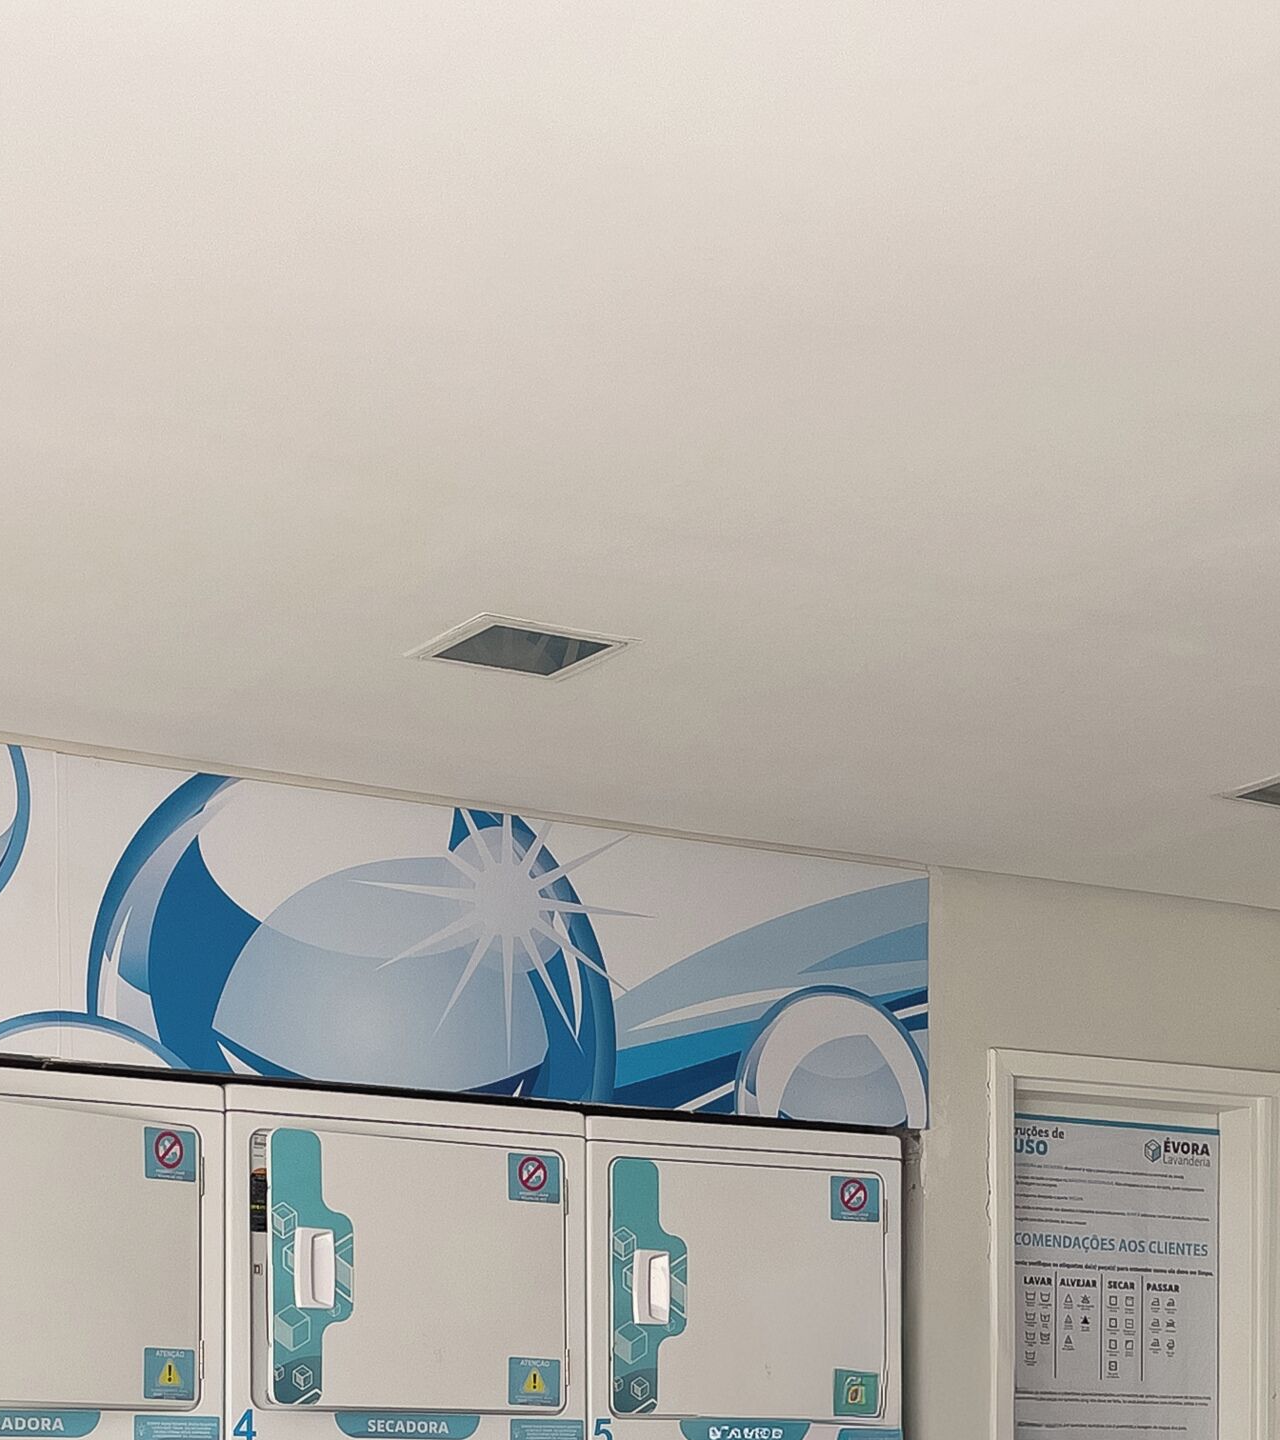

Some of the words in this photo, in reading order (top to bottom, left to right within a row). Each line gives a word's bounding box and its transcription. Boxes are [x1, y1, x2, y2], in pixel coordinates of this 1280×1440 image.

[1052, 1127, 1065, 1139] de
[1163, 1137, 1210, 1156] ÉVORA
[1163, 1154, 1211, 1167] Lavanderia
[1118, 1238, 1145, 1253] AOS
[1149, 1240, 1208, 1257] CLIENTES
[1024, 1276, 1052, 1286] LAVAR
[1059, 1278, 1097, 1288] ALVEJAR
[1107, 1280, 1135, 1290] SECAR
[1146, 1282, 1180, 1293] PASSAR
[367, 1419, 449, 1434] SECADORA
